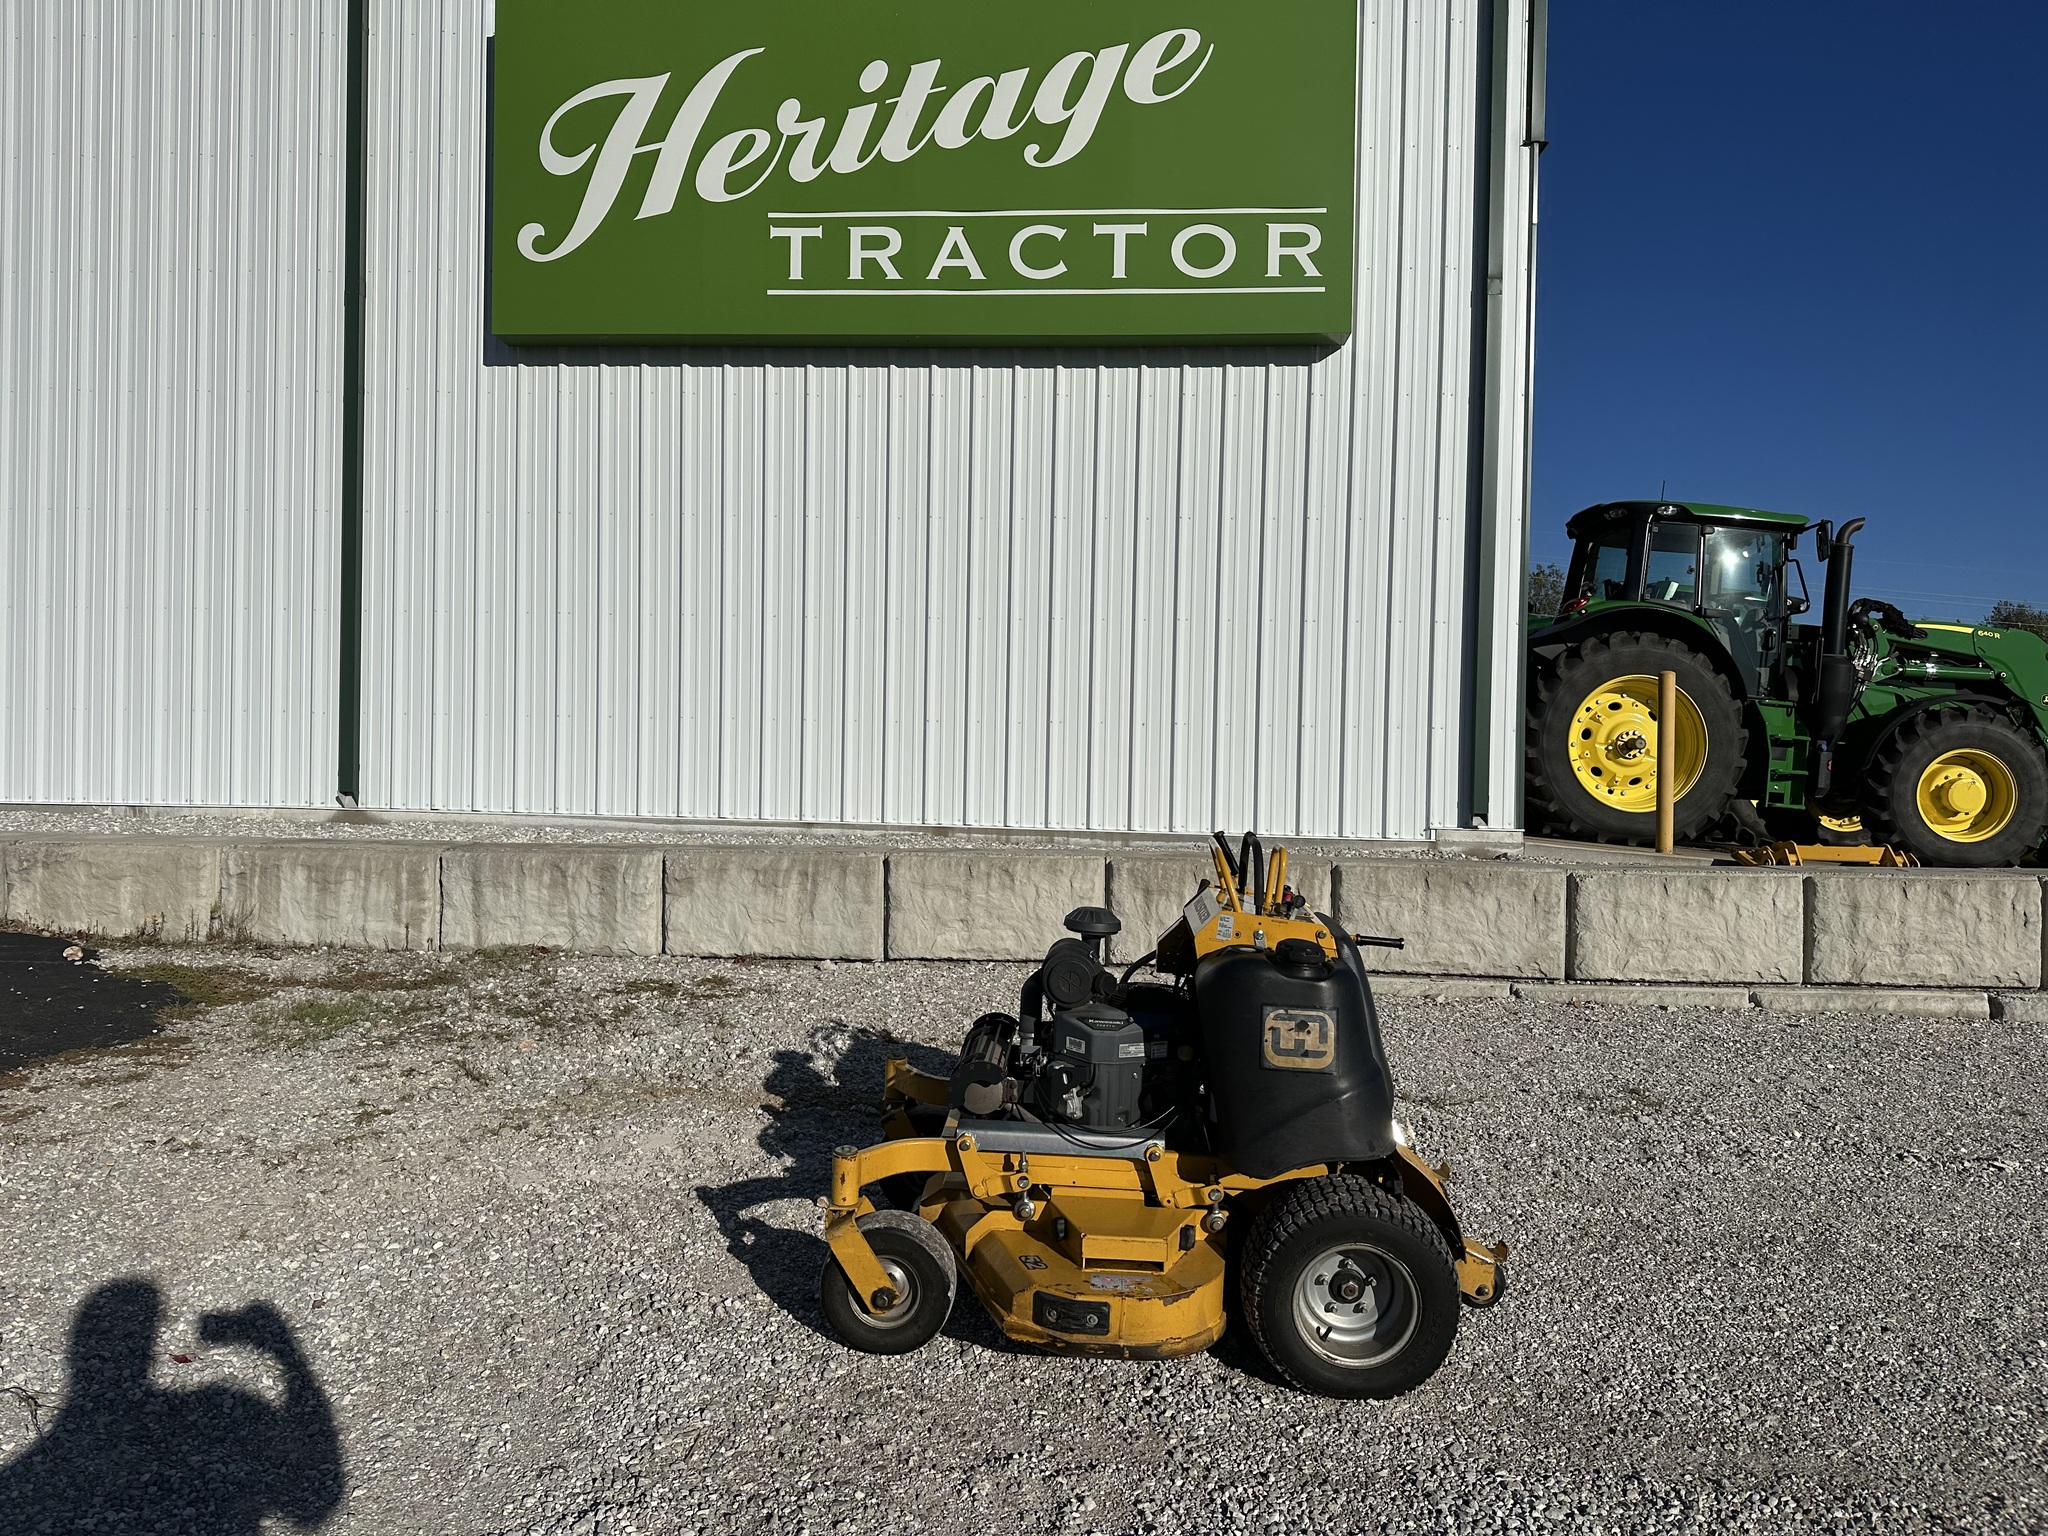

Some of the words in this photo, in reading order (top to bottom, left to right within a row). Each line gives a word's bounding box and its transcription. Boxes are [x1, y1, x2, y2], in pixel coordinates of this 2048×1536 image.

[517, 29, 1214, 262] Heritage
[770, 222, 1323, 279] TRACTOR
[1019, 1255, 1048, 1270] 52
